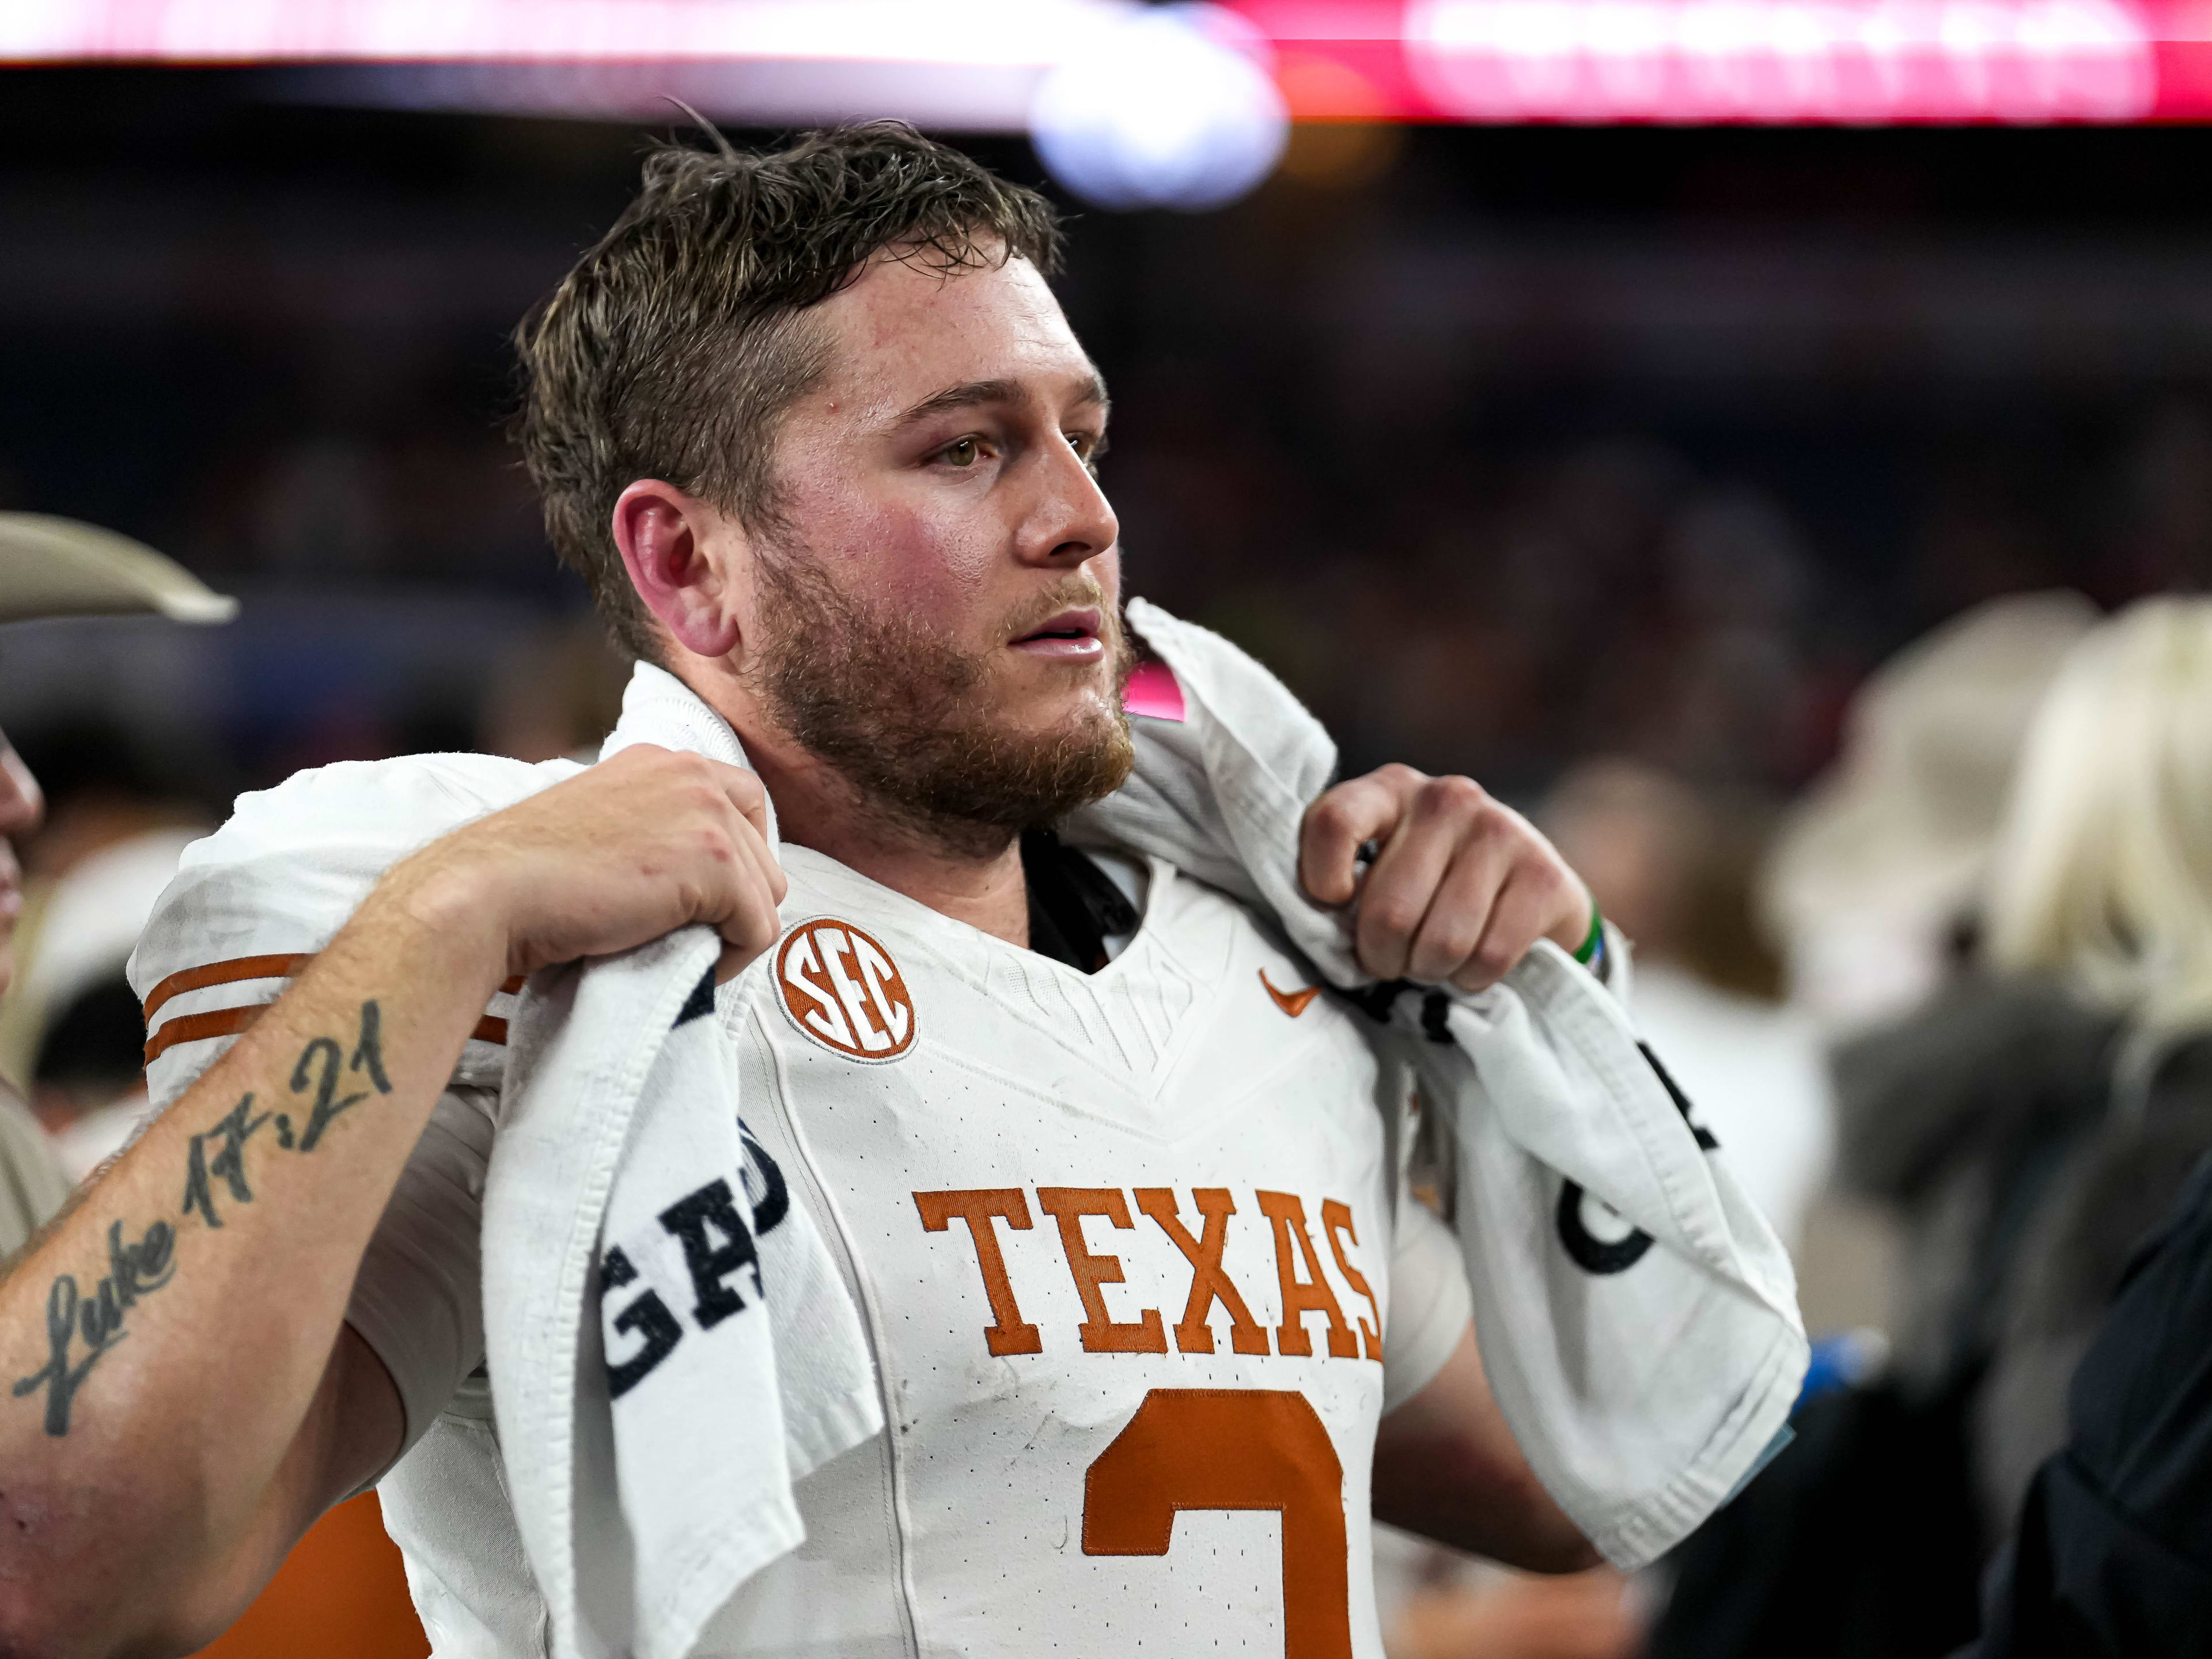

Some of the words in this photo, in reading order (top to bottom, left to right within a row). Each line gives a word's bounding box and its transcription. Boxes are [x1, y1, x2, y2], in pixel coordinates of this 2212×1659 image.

[784, 928, 908, 1052] SEC
[12, 1218, 177, 1437] Luke
[912, 1187, 1384, 1363] TEXAS
